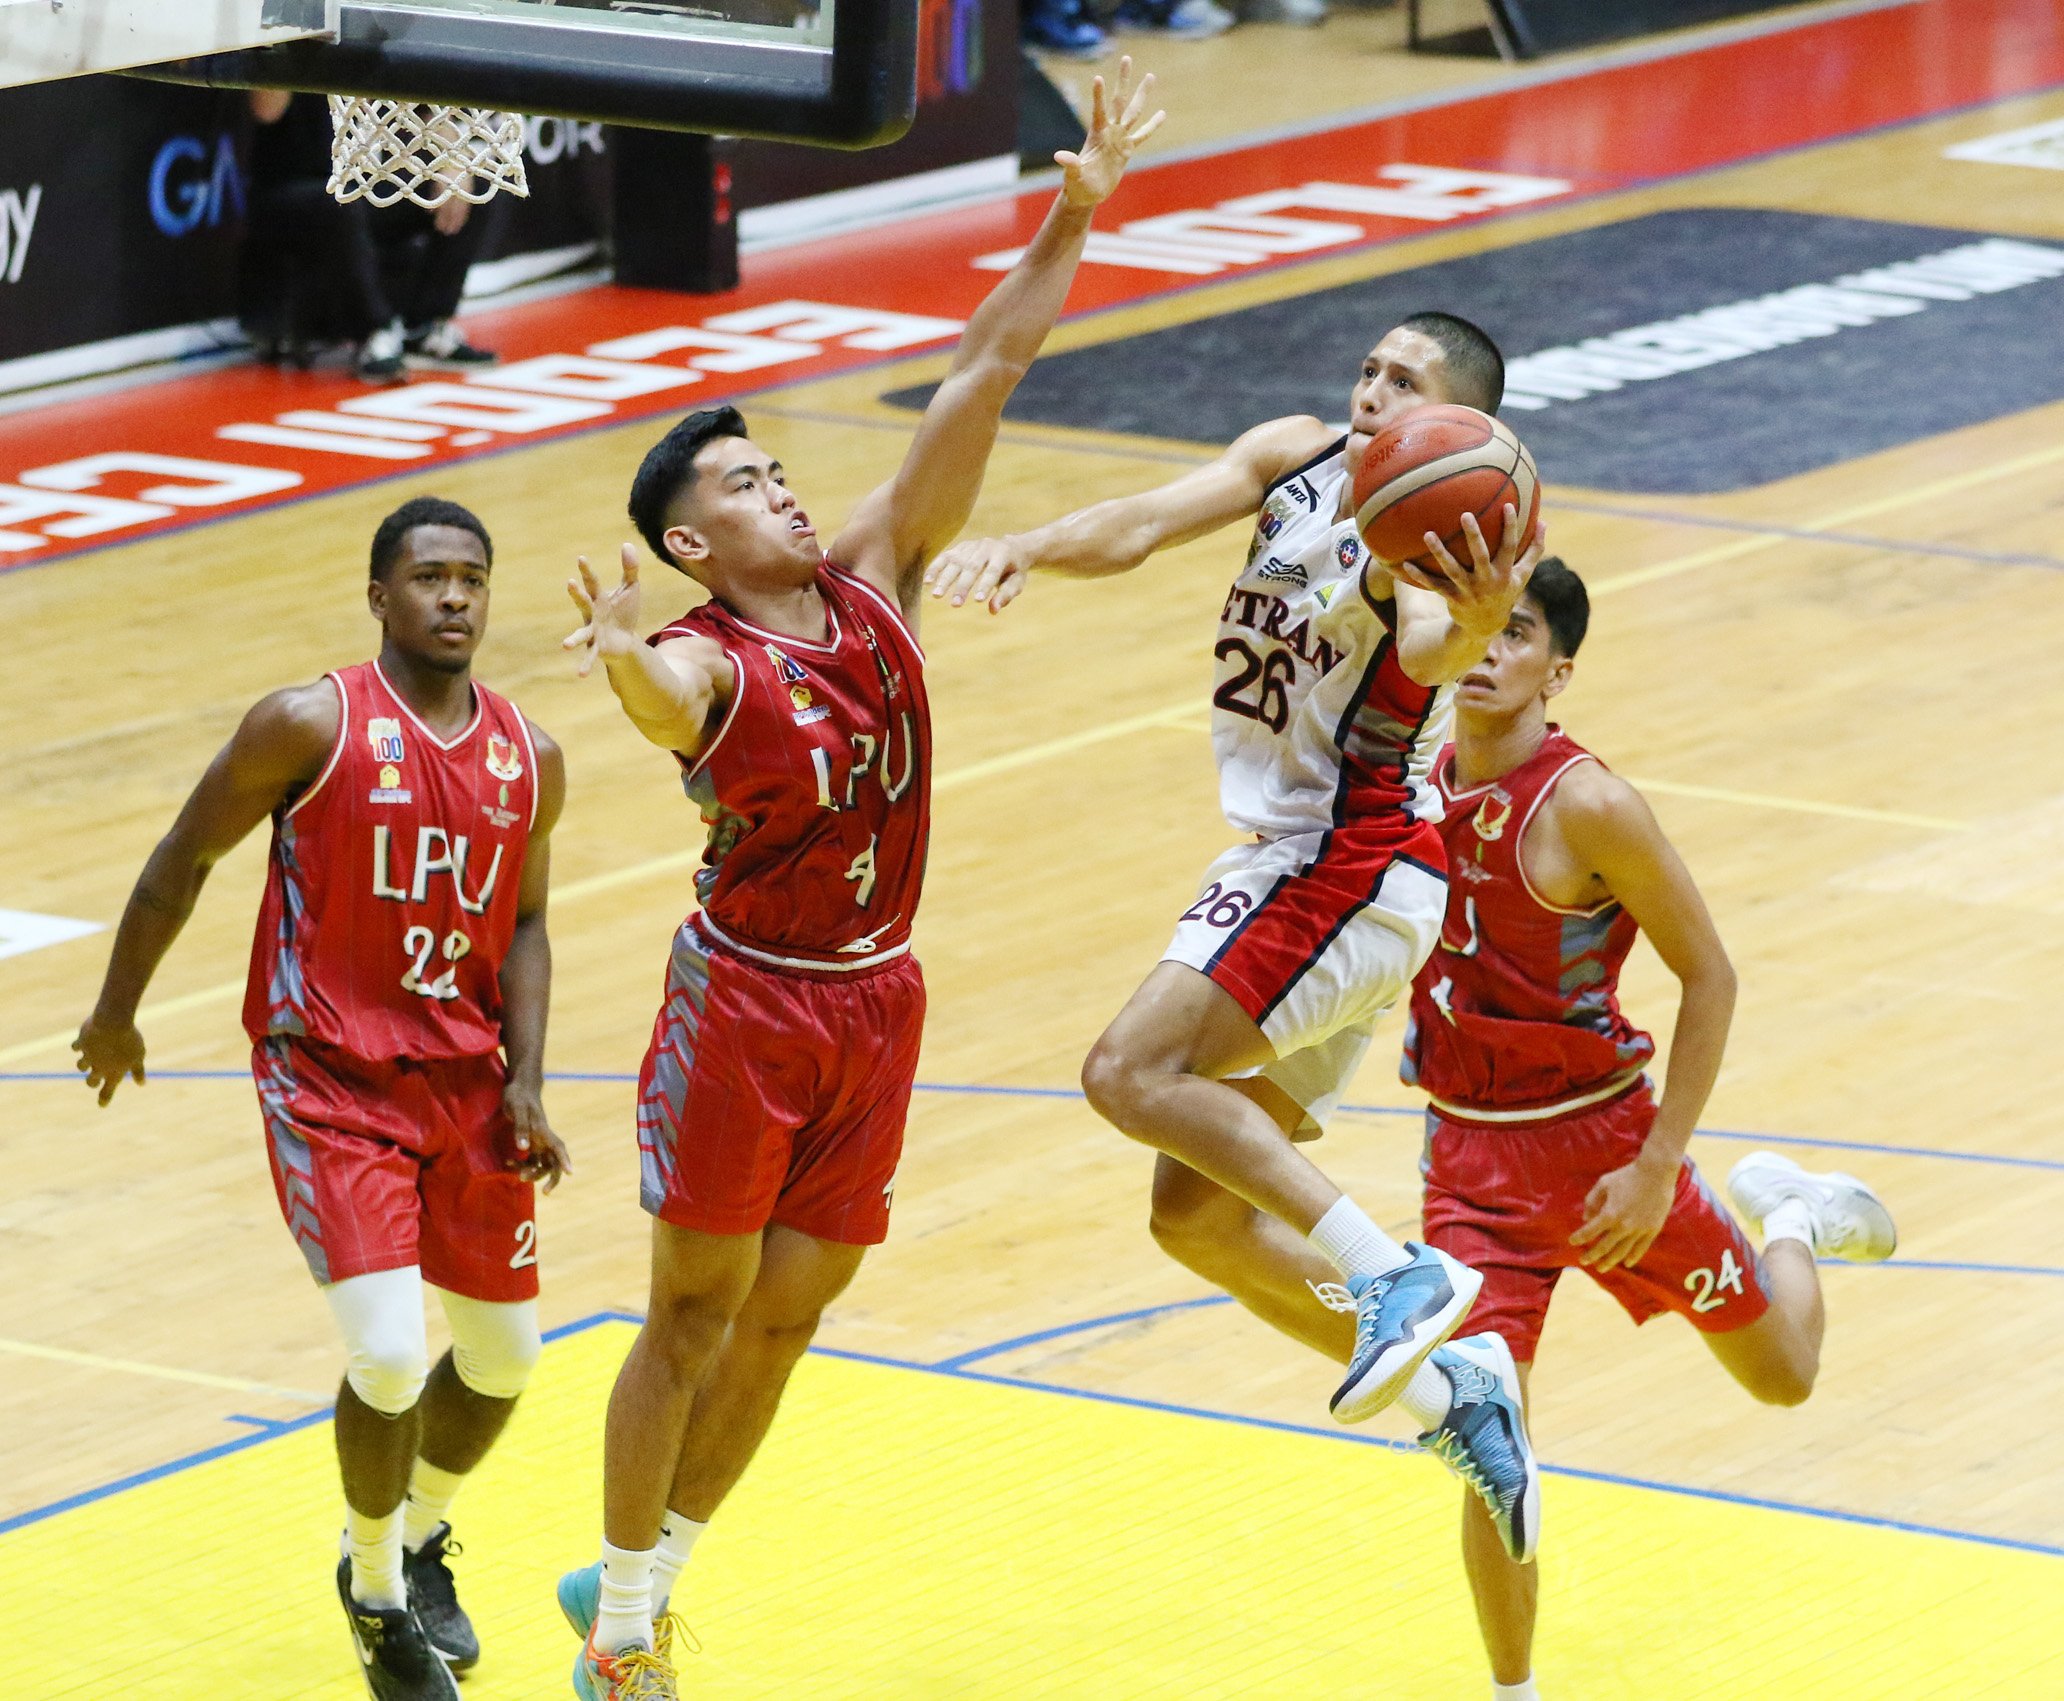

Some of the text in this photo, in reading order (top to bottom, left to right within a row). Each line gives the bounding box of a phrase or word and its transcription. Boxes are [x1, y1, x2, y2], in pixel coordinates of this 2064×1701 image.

[1284, 483, 1308, 505] ANTA
[1257, 569, 1309, 589] STRONG
[1213, 637, 1296, 736] 26
[371, 735, 405, 762] 100
[810, 711, 914, 814] LPU
[372, 824, 505, 915] LPU
[1178, 881, 1253, 929] 26
[1683, 1247, 1745, 1313] 24
